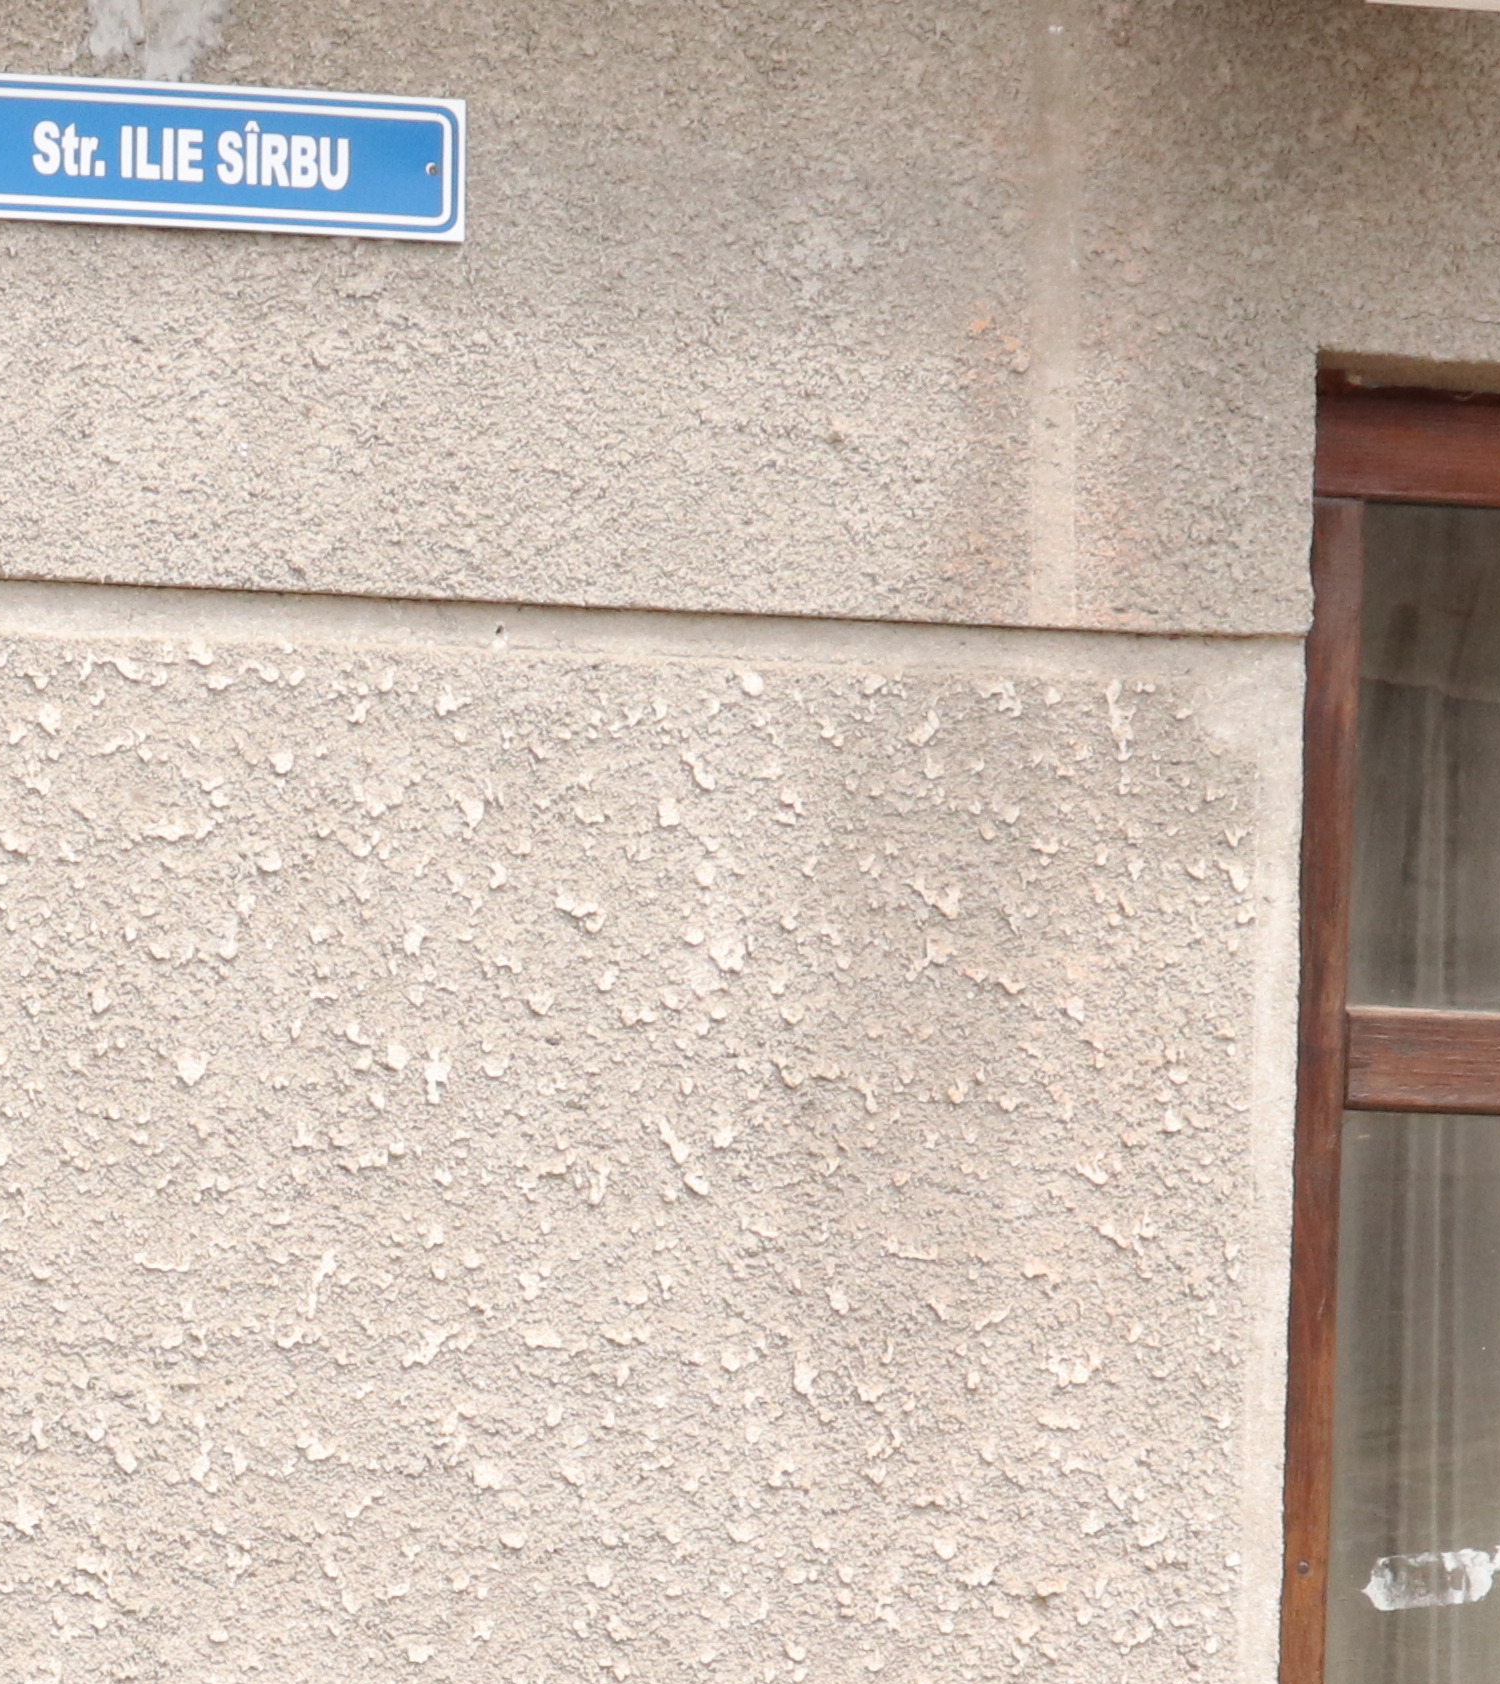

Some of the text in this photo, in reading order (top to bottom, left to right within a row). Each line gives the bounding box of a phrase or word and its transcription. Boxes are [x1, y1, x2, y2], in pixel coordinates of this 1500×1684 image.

[31, 120, 351, 191] Str. ILIE SÎRBU
